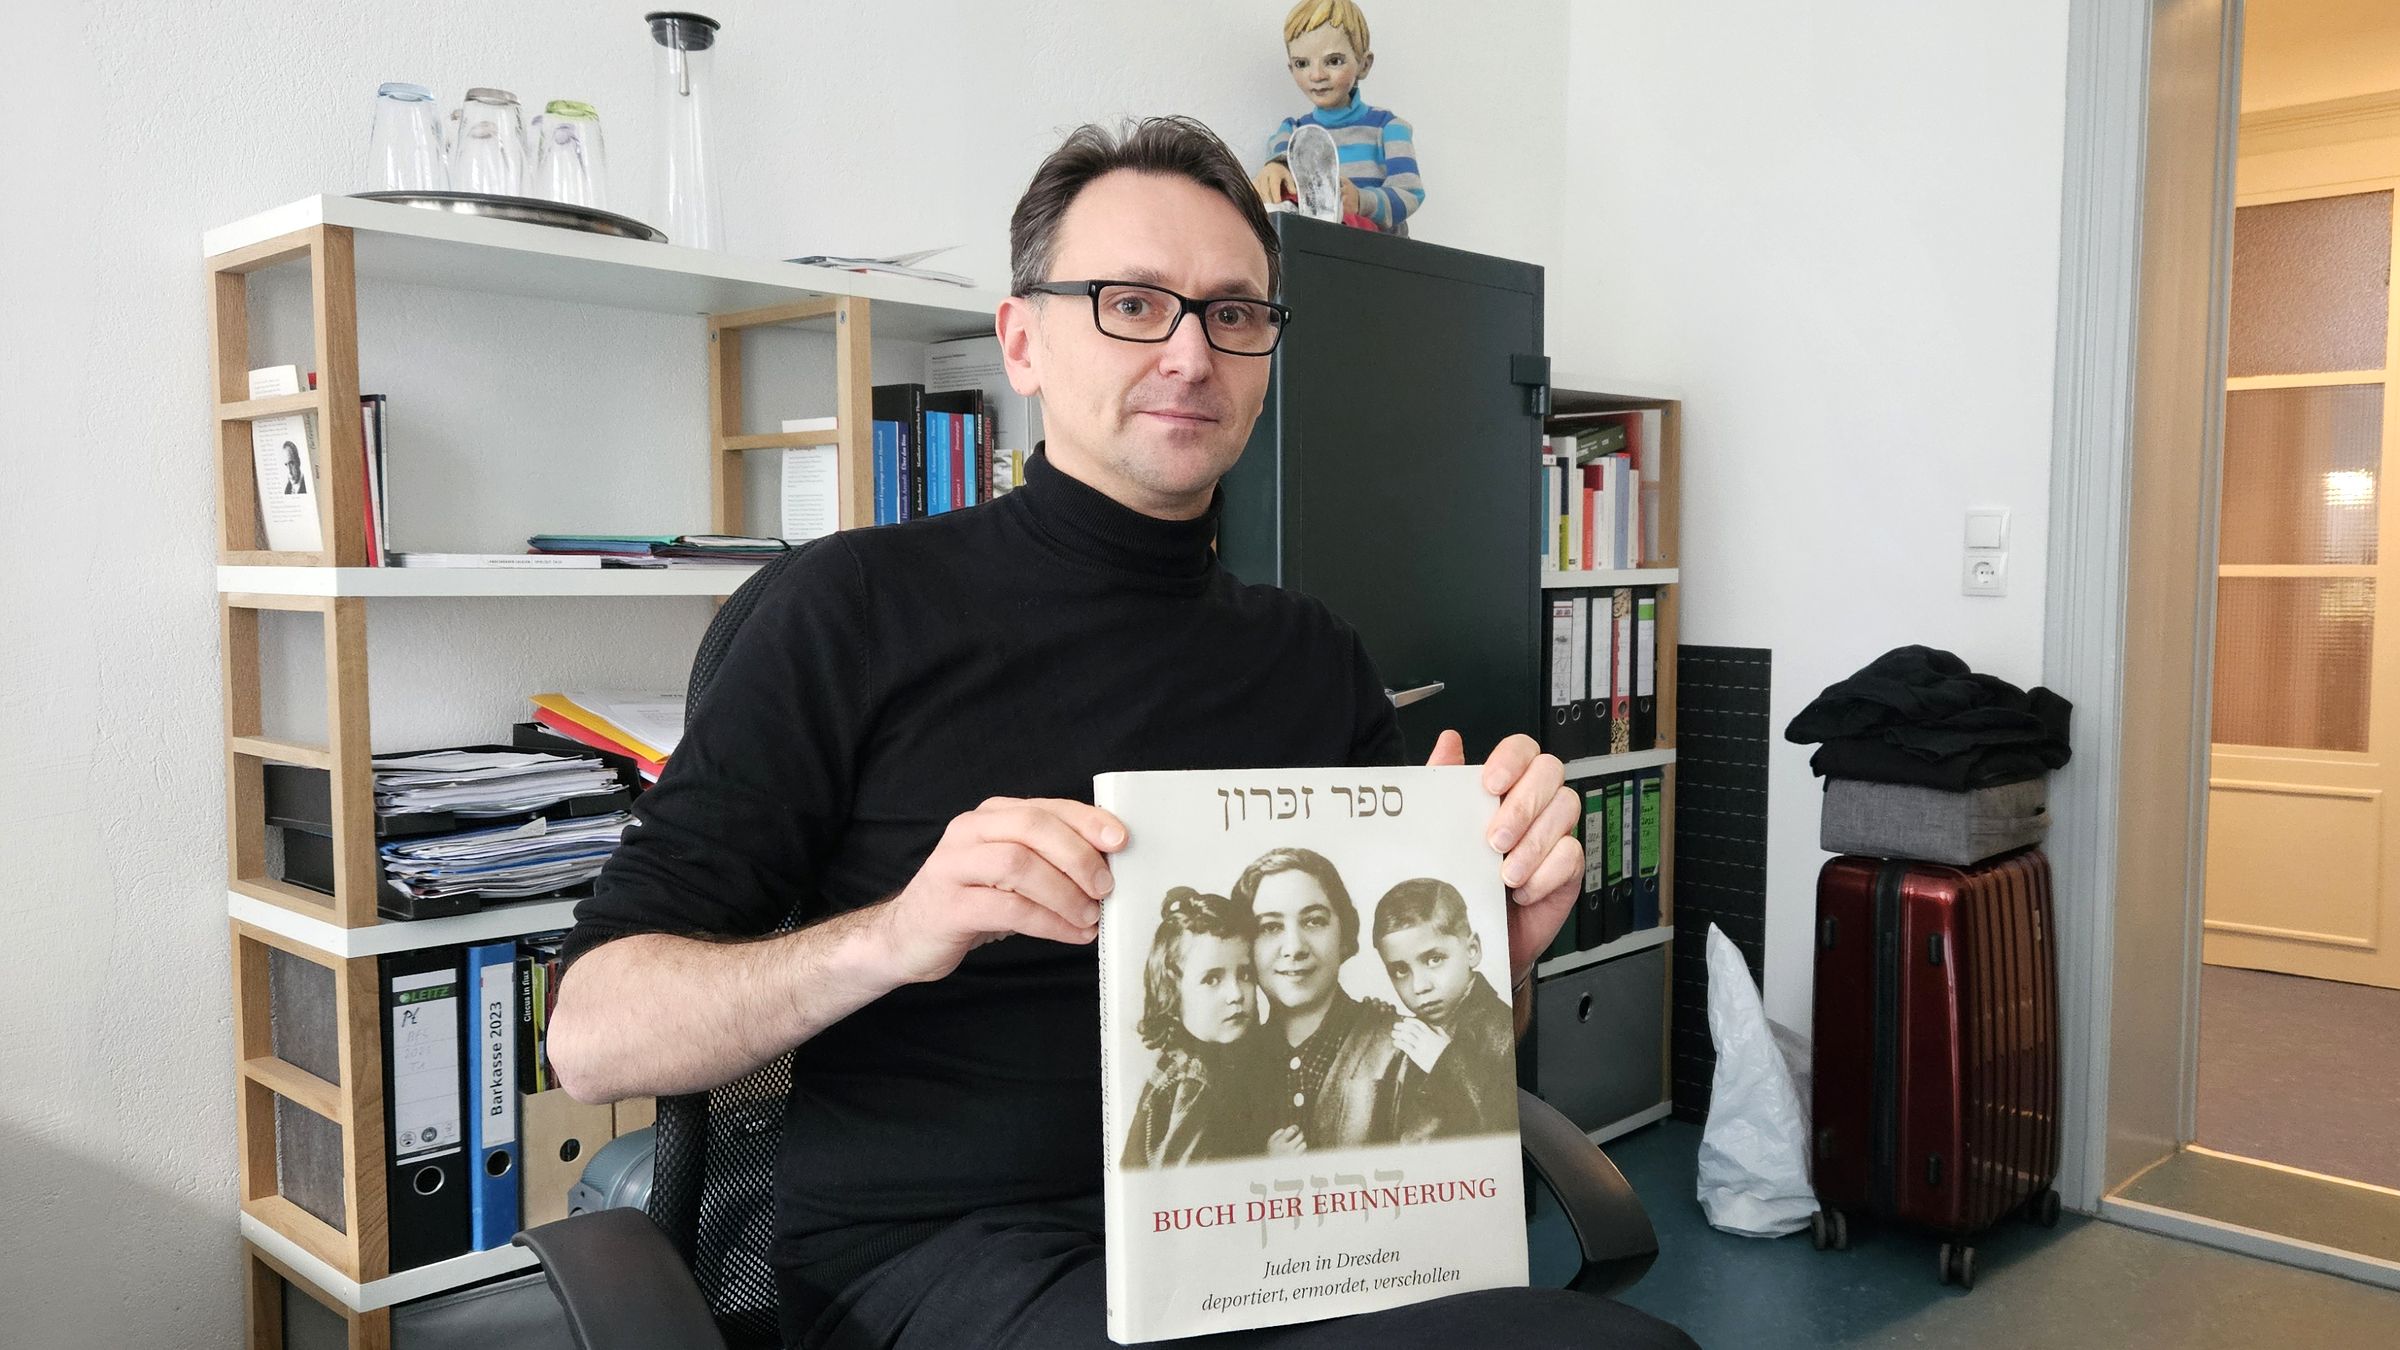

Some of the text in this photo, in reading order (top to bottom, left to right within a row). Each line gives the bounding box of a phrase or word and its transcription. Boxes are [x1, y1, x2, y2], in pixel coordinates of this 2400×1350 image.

[1331, 784, 1404, 818] ספר
[411, 986, 450, 1002] LEITZ
[521, 969, 532, 1022] Circus in flux
[489, 1001, 503, 1117] Barkasse 2023
[1153, 1177, 1497, 1233] BUCH DER ERINNERUNG
[1263, 1248, 1401, 1280] Juden in Dresden
[1201, 1266, 1462, 1314] deportiert, ermordet, verschollen
